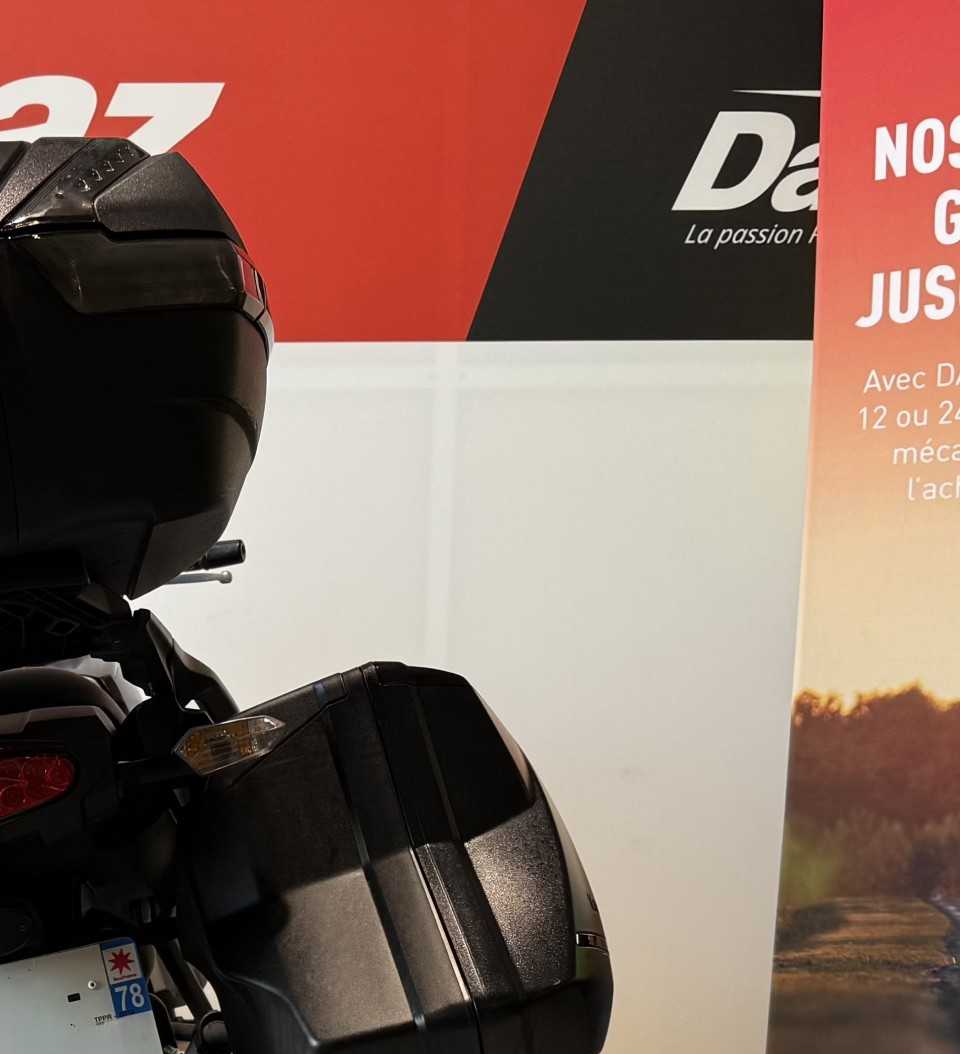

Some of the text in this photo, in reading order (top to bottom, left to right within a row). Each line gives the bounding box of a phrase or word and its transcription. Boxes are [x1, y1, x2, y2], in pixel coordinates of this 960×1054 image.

[684, 224, 714, 244] La
[713, 224, 804, 250] passion
[863, 369, 926, 393] Avec
[858, 405, 887, 430] 12
[896, 409, 928, 428] ou
[114, 983, 145, 1011] 78
